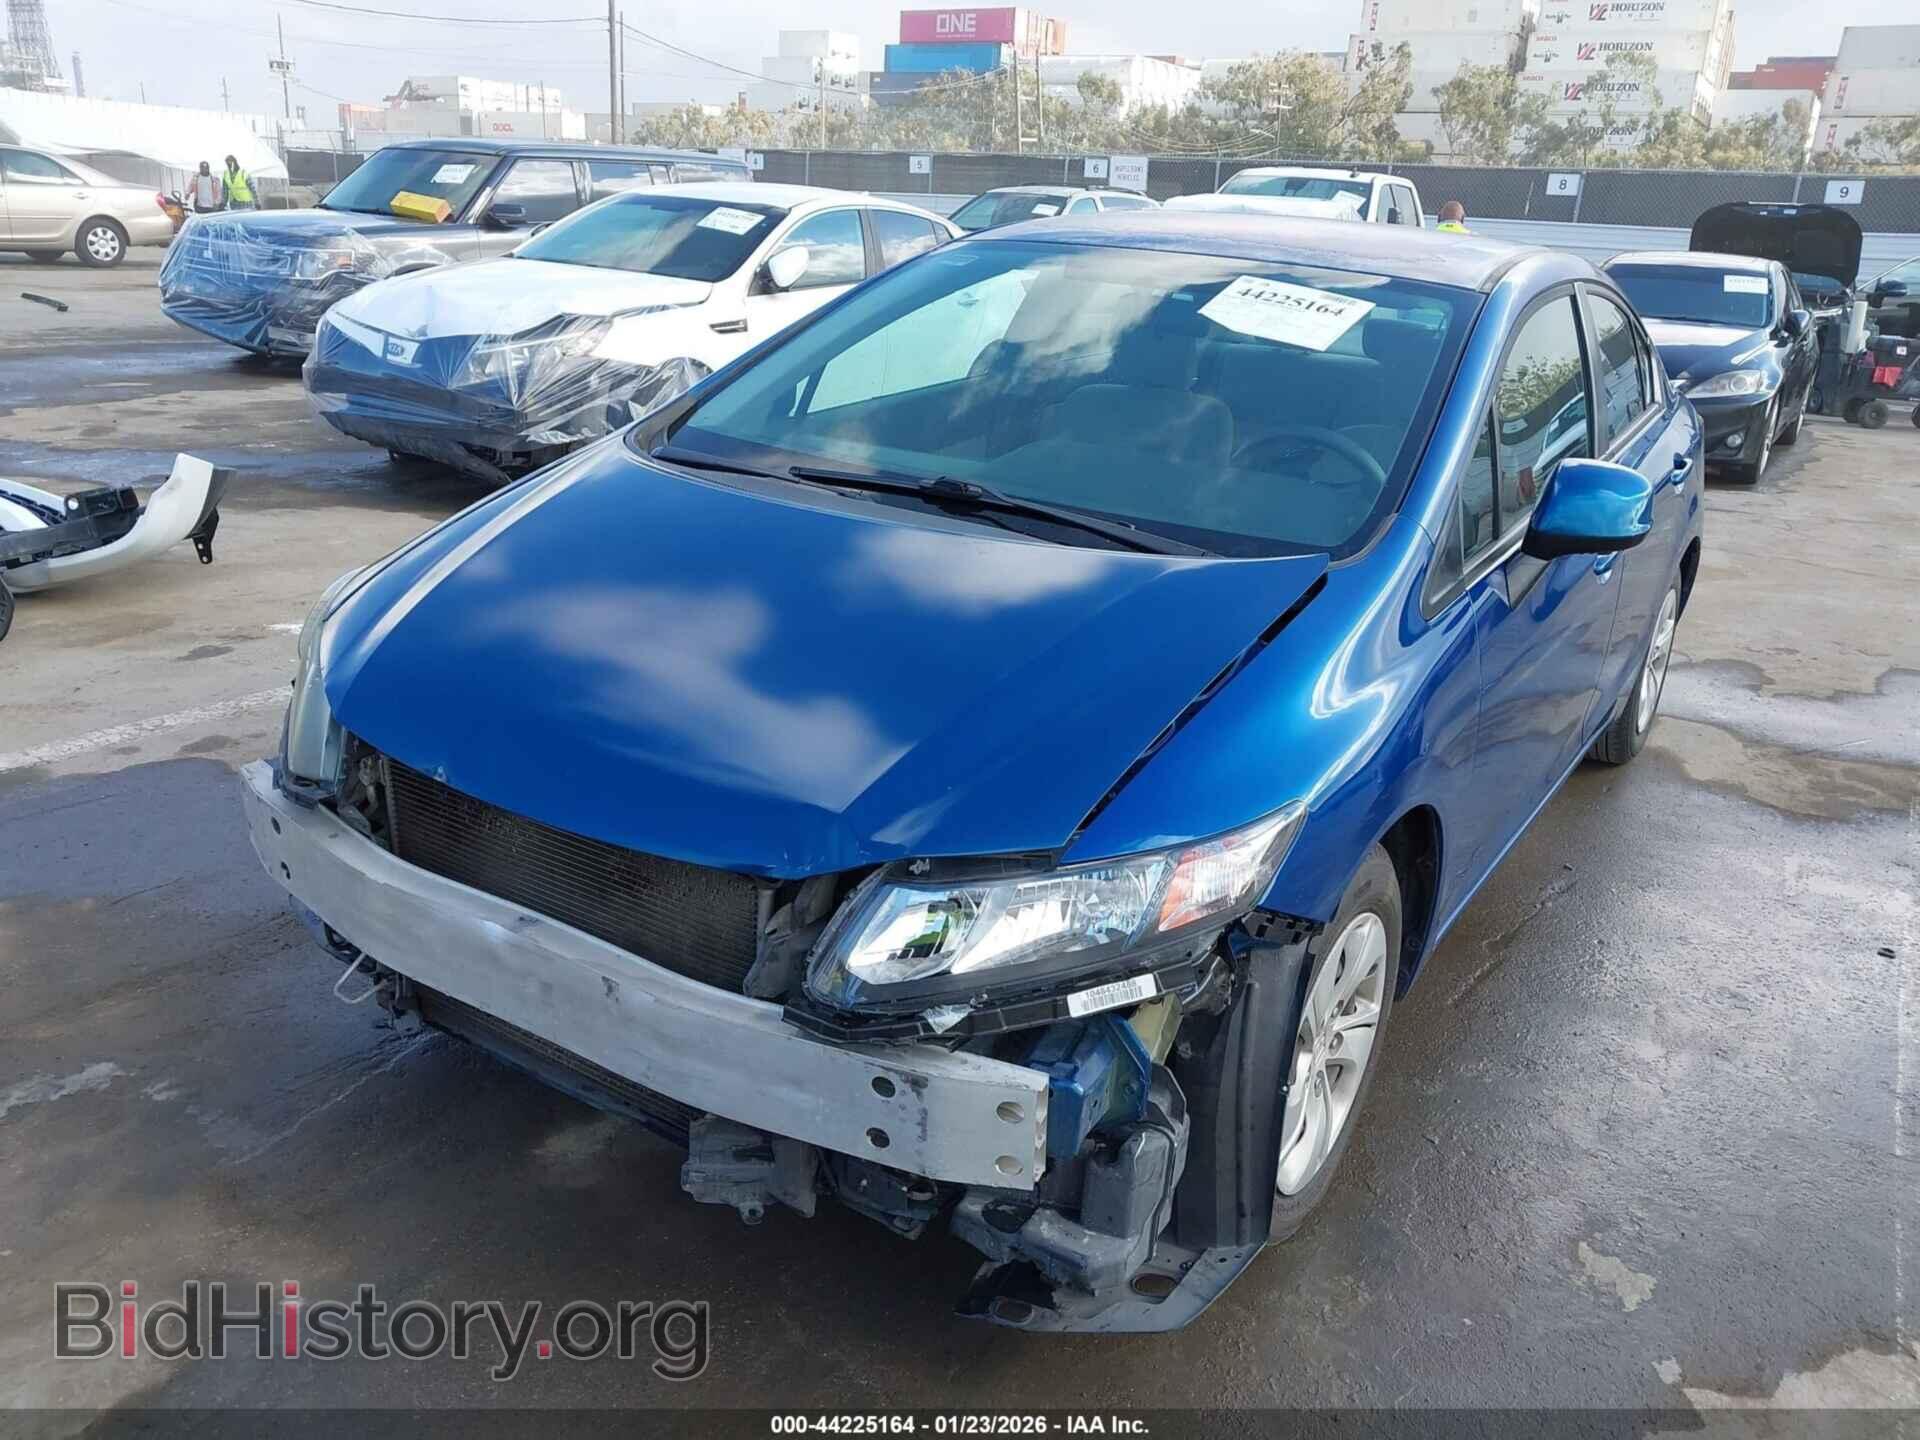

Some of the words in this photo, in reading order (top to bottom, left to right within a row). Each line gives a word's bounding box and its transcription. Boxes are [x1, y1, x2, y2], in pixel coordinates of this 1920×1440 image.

[1610, 2, 1664, 12] HORIZON
[936, 13, 976, 33] ONE
[1599, 42, 1653, 52] HORIZON
[1093, 164, 1099, 174] 6
[1559, 179, 1567, 190] 8
[1840, 186, 1849, 198] 9
[1237, 287, 1345, 317] 44225164
